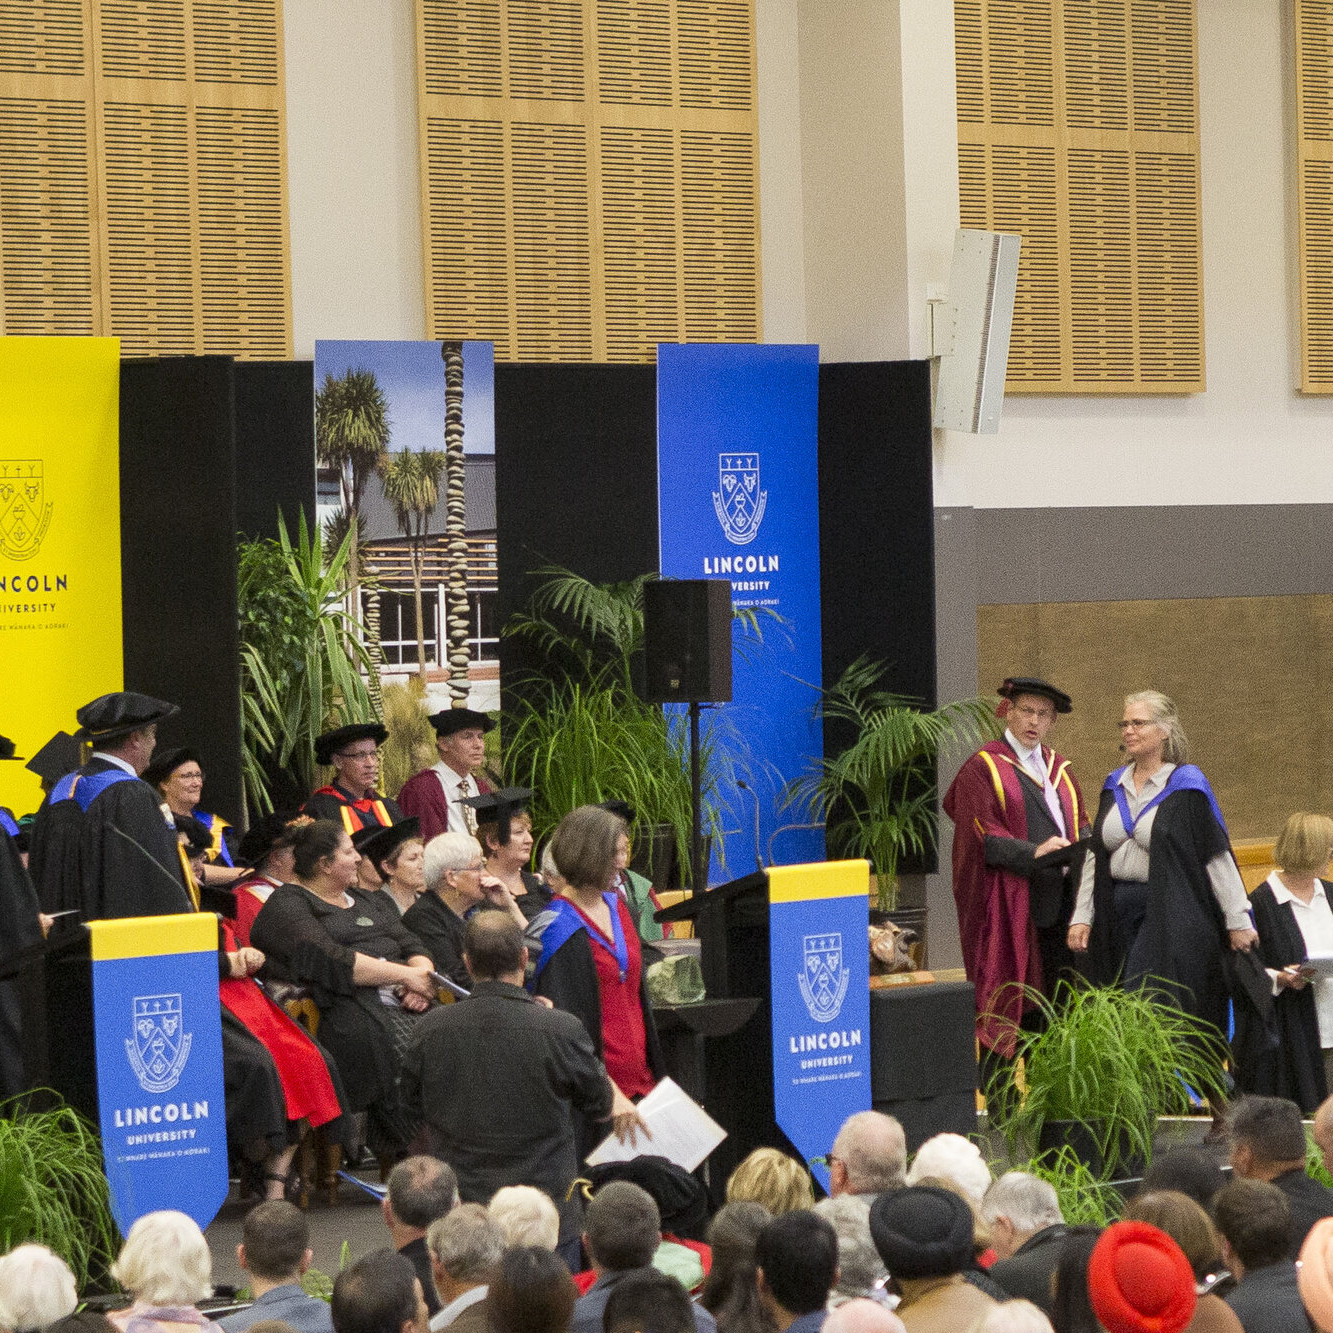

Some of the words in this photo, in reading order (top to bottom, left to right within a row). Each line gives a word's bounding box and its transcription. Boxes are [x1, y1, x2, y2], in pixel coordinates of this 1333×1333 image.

[703, 555, 779, 574] LINCOLN
[731, 581, 770, 591] VERSITY
[790, 1029, 861, 1053] LINCOLN
[801, 1054, 853, 1070] UNIVERSITY
[114, 1100, 209, 1128] LINCOLN
[127, 1128, 196, 1146] UNIVERSITY
